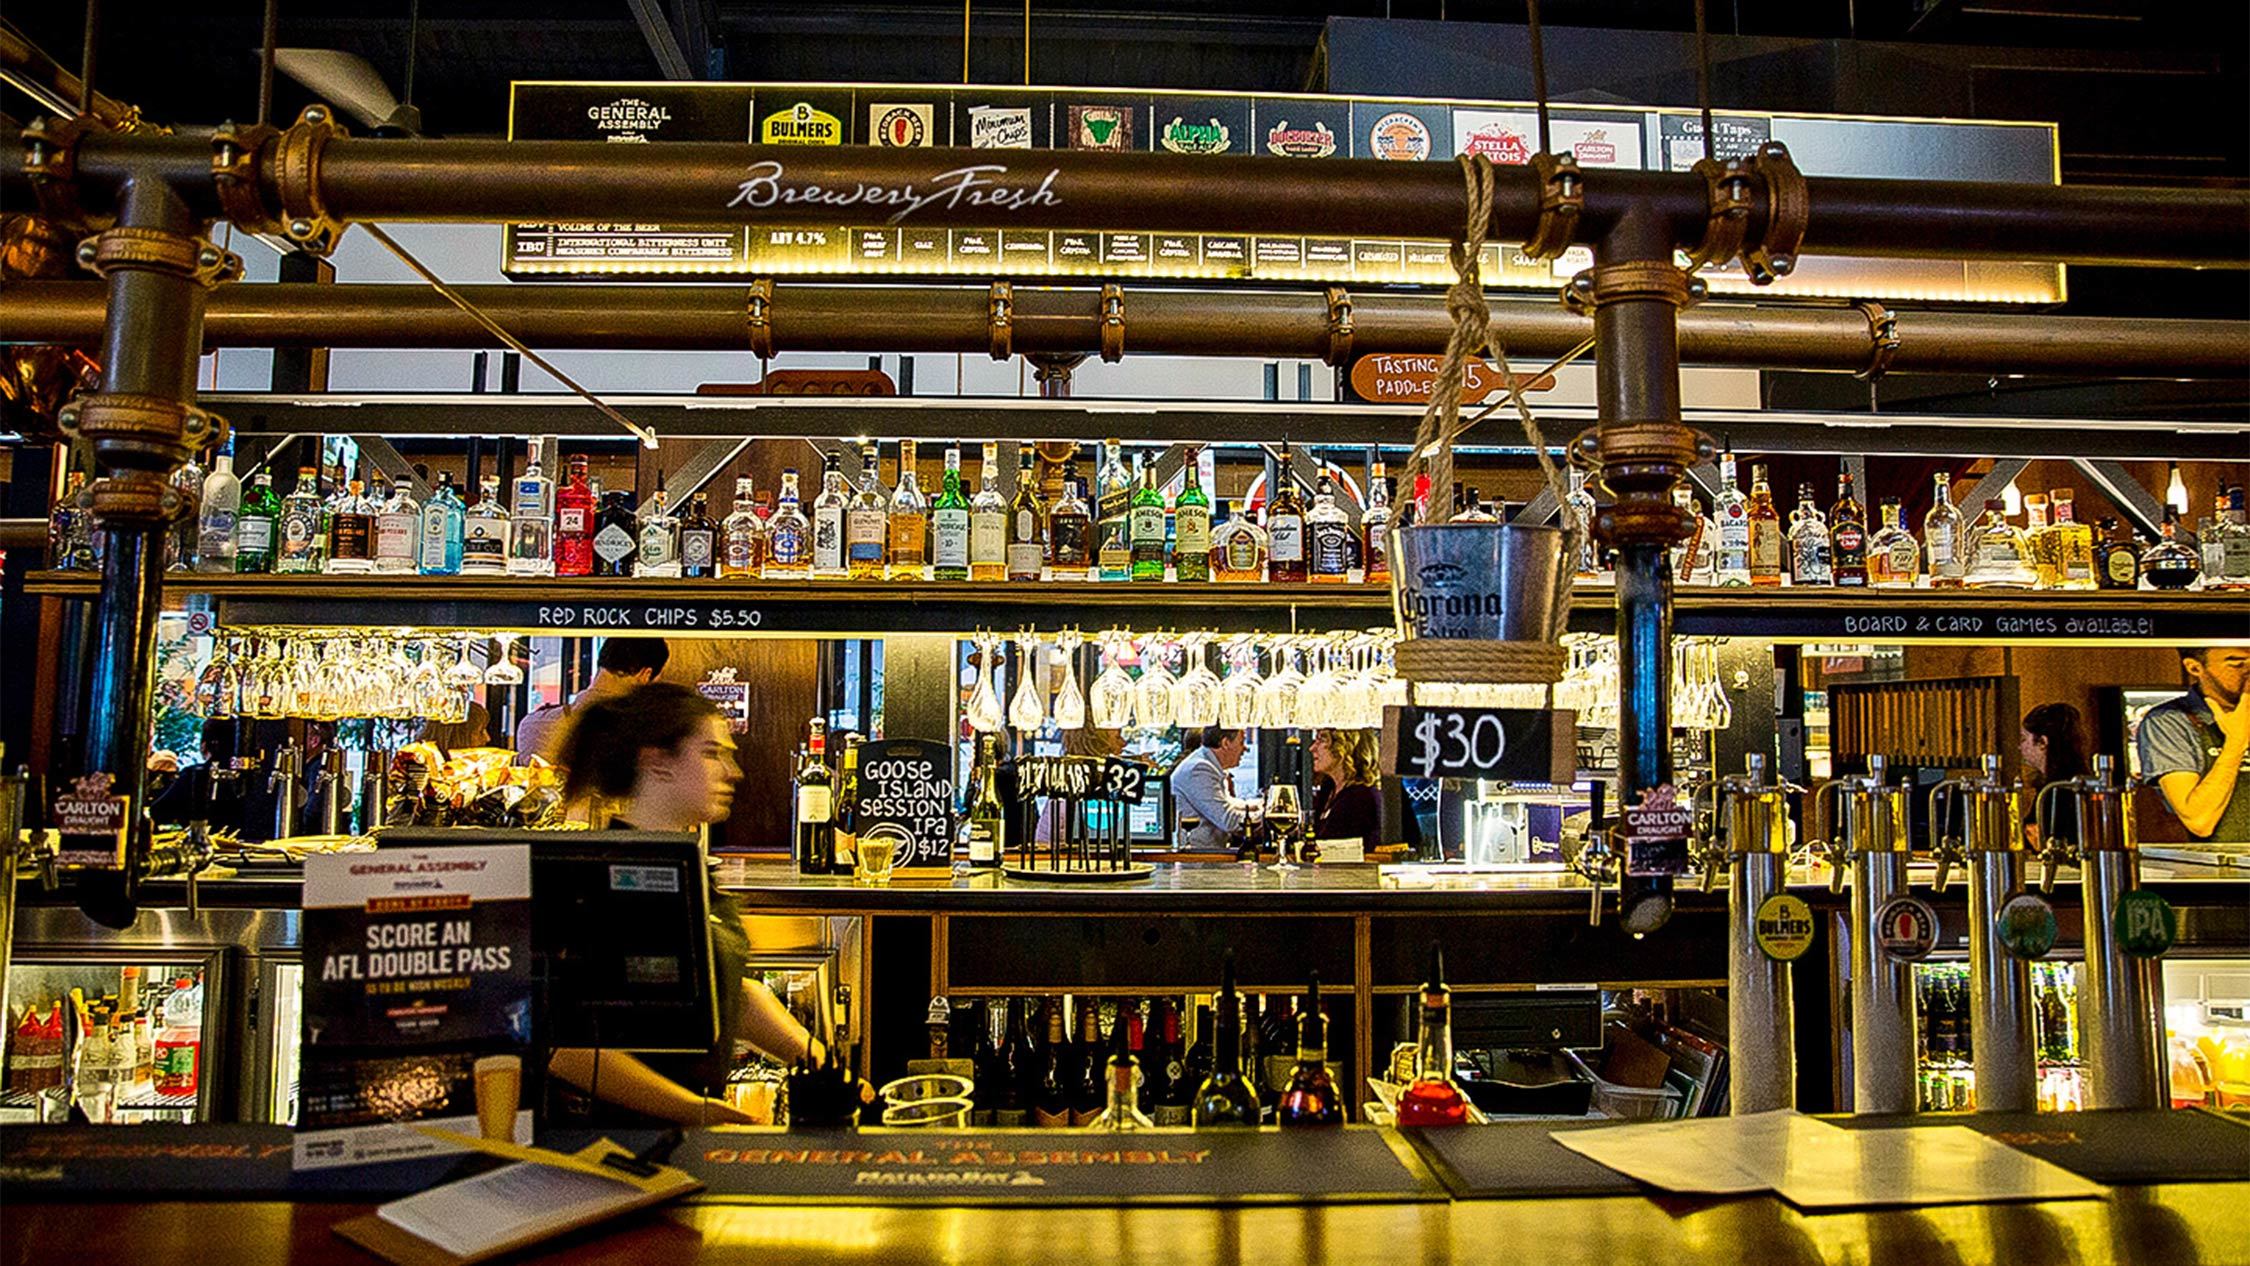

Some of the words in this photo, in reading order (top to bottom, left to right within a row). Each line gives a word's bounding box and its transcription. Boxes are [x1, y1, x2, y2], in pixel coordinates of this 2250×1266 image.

[620, 98, 639, 106] THE
[587, 106, 671, 120] GENERAL
[798, 106, 809, 120] B
[597, 119, 661, 129] ASSEMBLY
[771, 121, 832, 138] BULMERS
[975, 115, 1024, 136] Minimum
[1682, 121, 1719, 134] Gut
[1720, 123, 1752, 138] Taps
[996, 127, 1028, 143] Chips
[1169, 124, 1223, 142] ALPHA
[1473, 140, 1520, 152] STELLA
[1576, 145, 1613, 153] CARLTON
[1482, 152, 1520, 162] RTOIS
[727, 161, 923, 224] Brewery
[928, 165, 1062, 210] Fresh
[597, 224, 611, 232] OF
[557, 239, 636, 247] INTERNATIONAL
[643, 239, 699, 247] BITTERNESS
[795, 233, 826, 245] 4.7%
[517, 242, 545, 252] IBU
[1371, 356, 1438, 374] TASTING
[1133, 510, 1163, 519] JAMESON
[1177, 509, 1208, 519] JAMESON
[565, 517, 579, 526] 24
[1400, 587, 1503, 621] Corona
[583, 608, 631, 625] ROCK
[645, 608, 698, 626] CHIPS
[708, 609, 762, 628] $5.50
[1915, 617, 1930, 631] &
[1419, 620, 1469, 638] Extra
[1411, 712, 1506, 778] $30
[1106, 764, 1141, 798] 32
[54, 802, 120, 815] CARLTON
[63, 816, 110, 825] DRAUGHT
[1627, 812, 1692, 825] CARLTON
[1637, 825, 1684, 835] DRAUGHT
[918, 837, 949, 861] $12
[350, 863, 413, 875] GENERAL
[417, 861, 487, 873] ASSEMBLY
[1780, 905, 1791, 919] B
[1759, 919, 1811, 935] BULMERS
[2126, 901, 2168, 941] IPA
[366, 922, 438, 949] SCORE
[442, 921, 471, 945] AN
[323, 955, 364, 981] AFL
[368, 950, 453, 978] DOUBLE
[457, 946, 511, 972] PASS
[703, 1149, 939, 1165] GENERAL
[949, 1148, 1211, 1165] ASSEMBLY
